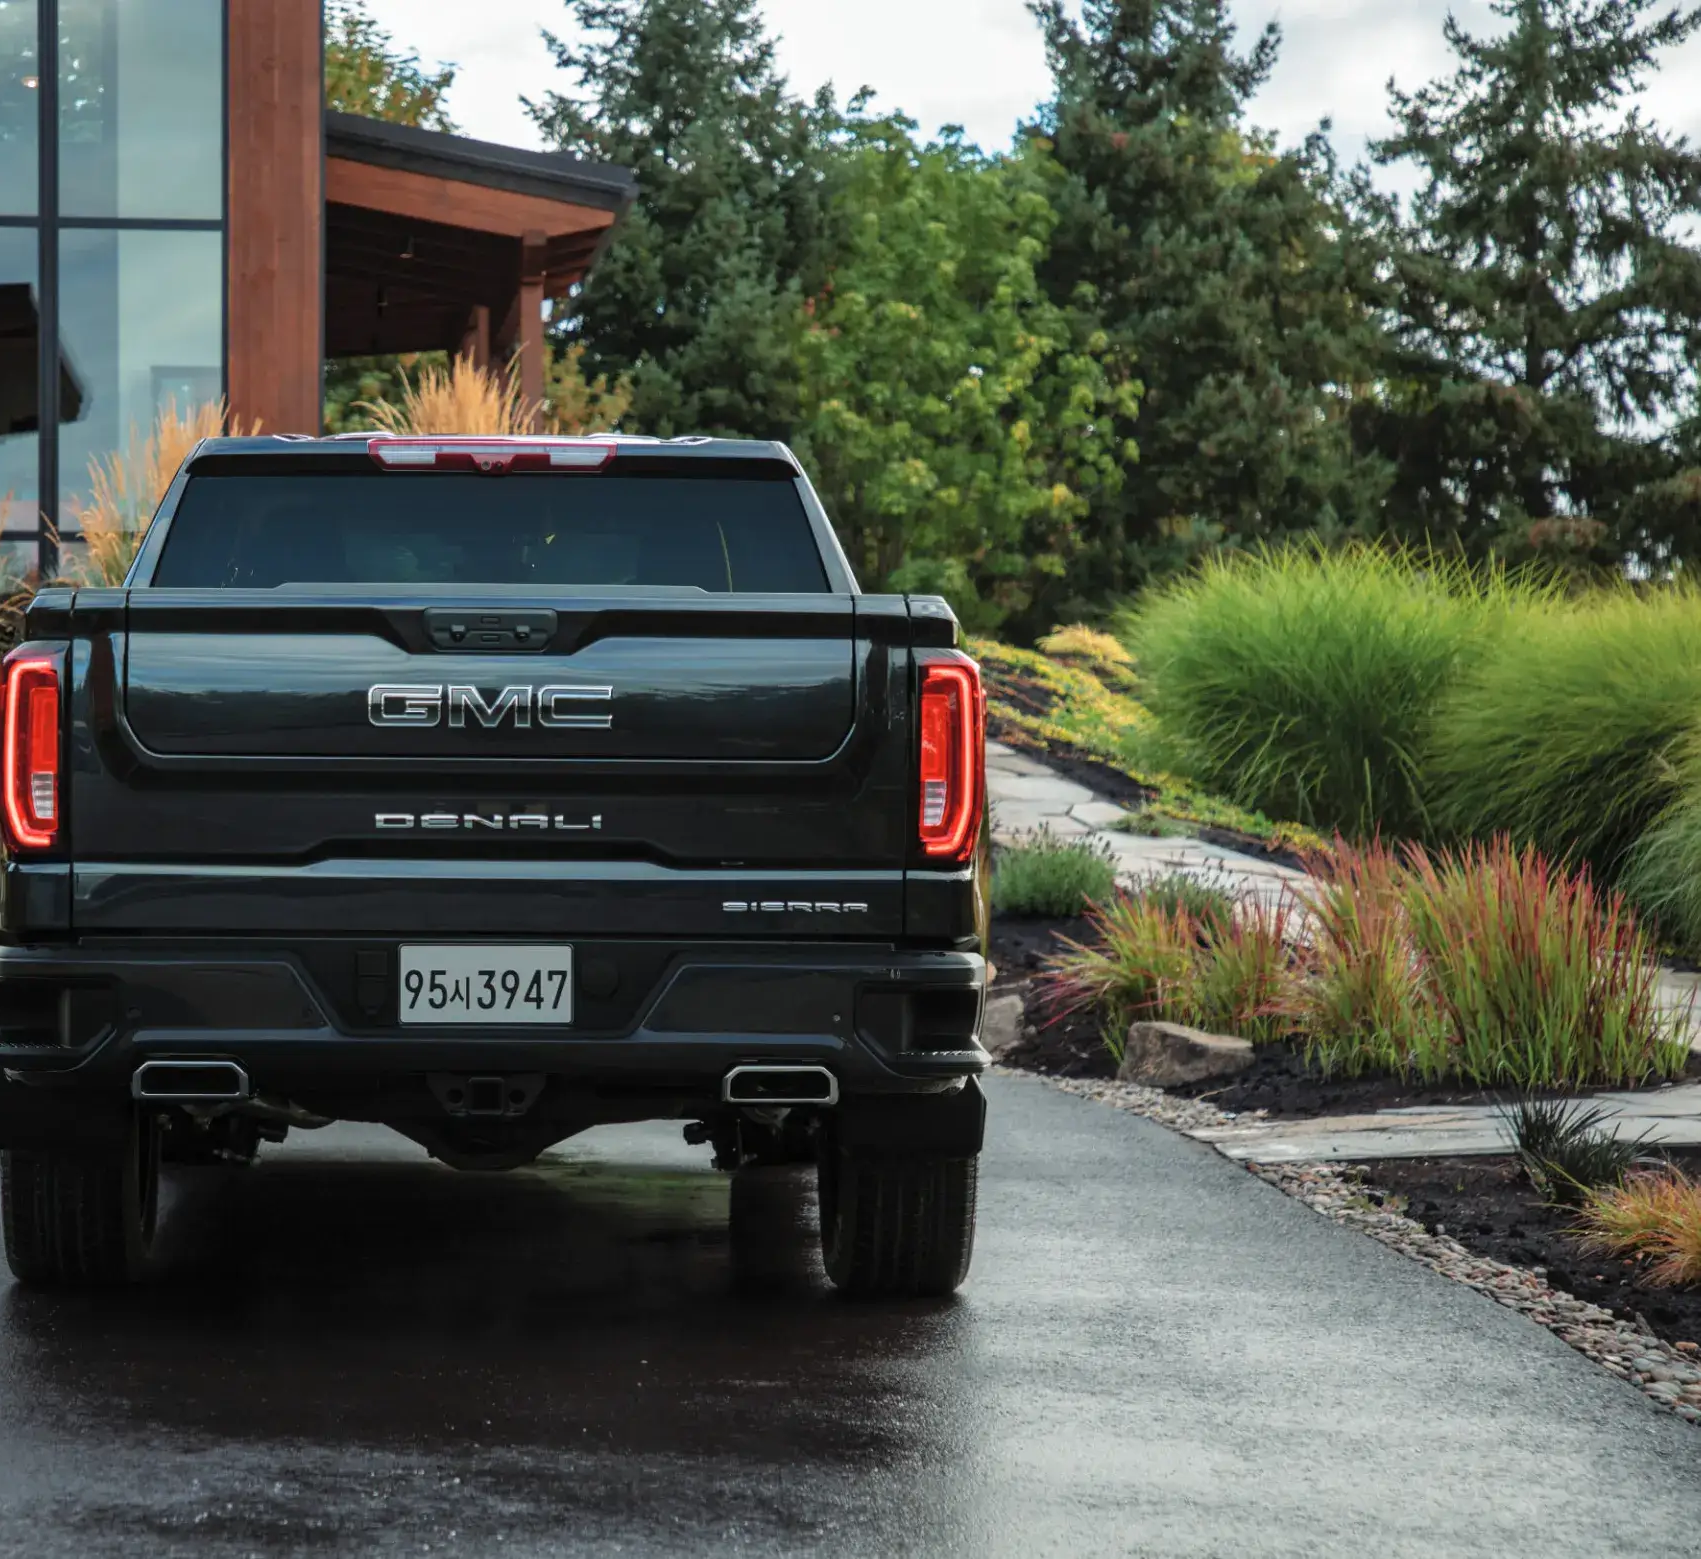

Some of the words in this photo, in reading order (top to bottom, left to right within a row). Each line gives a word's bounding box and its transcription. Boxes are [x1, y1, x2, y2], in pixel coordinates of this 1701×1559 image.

[367, 683, 614, 729] GMC
[374, 813, 602, 830] DENALI
[722, 901, 868, 913] SIERRA
[404, 969, 568, 1010] 95시3947
